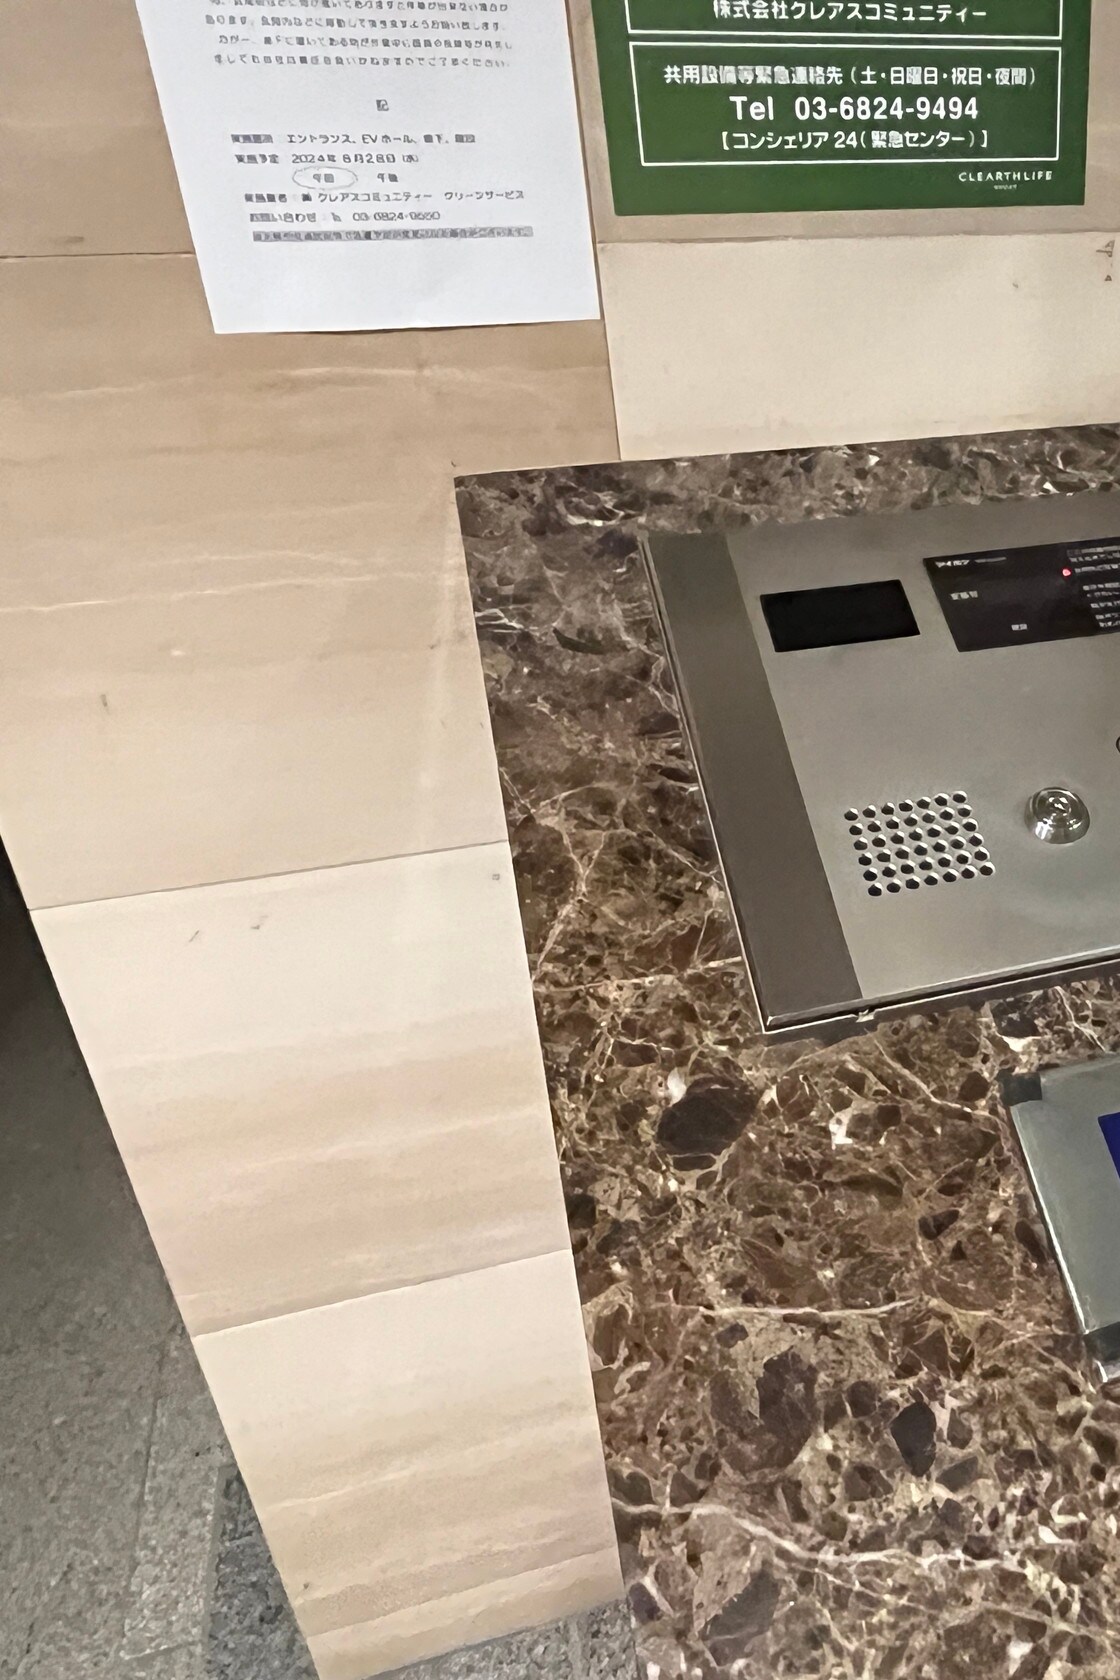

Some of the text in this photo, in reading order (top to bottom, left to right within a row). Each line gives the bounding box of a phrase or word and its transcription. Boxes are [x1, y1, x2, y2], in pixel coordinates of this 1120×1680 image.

[713, 0, 987, 23] 株式会社クレアスコミュニティー
[729, 96, 978, 121] Tel 03-6824-9494
